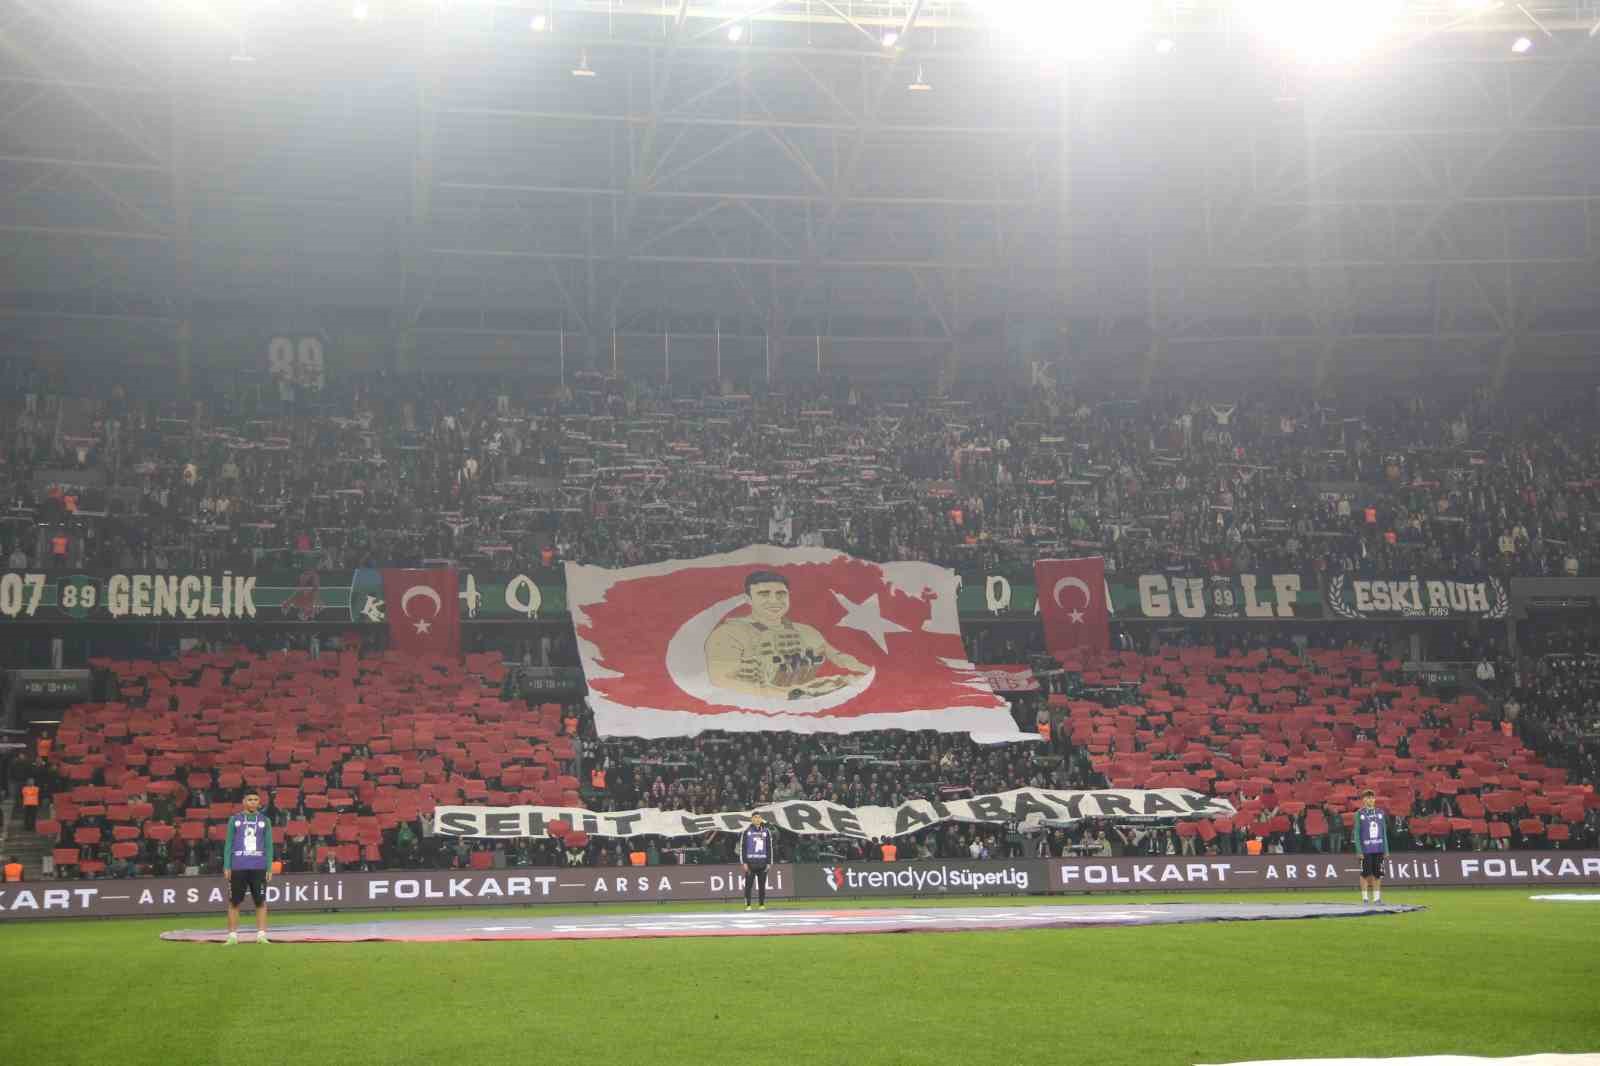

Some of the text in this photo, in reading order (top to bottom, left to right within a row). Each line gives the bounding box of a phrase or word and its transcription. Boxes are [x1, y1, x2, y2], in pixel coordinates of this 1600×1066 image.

[107, 571, 257, 619] GENÇLİK
[1353, 575, 1490, 612] ESKİ RUH
[846, 865, 947, 891] trendyol
[1061, 859, 1440, 884] FOLKART ARSA İKİLİ
[139, 888, 223, 904] ARSA
[265, 880, 343, 902] DİKİLİ
[369, 876, 556, 899] FOLKART
[594, 876, 672, 892] ARSA
